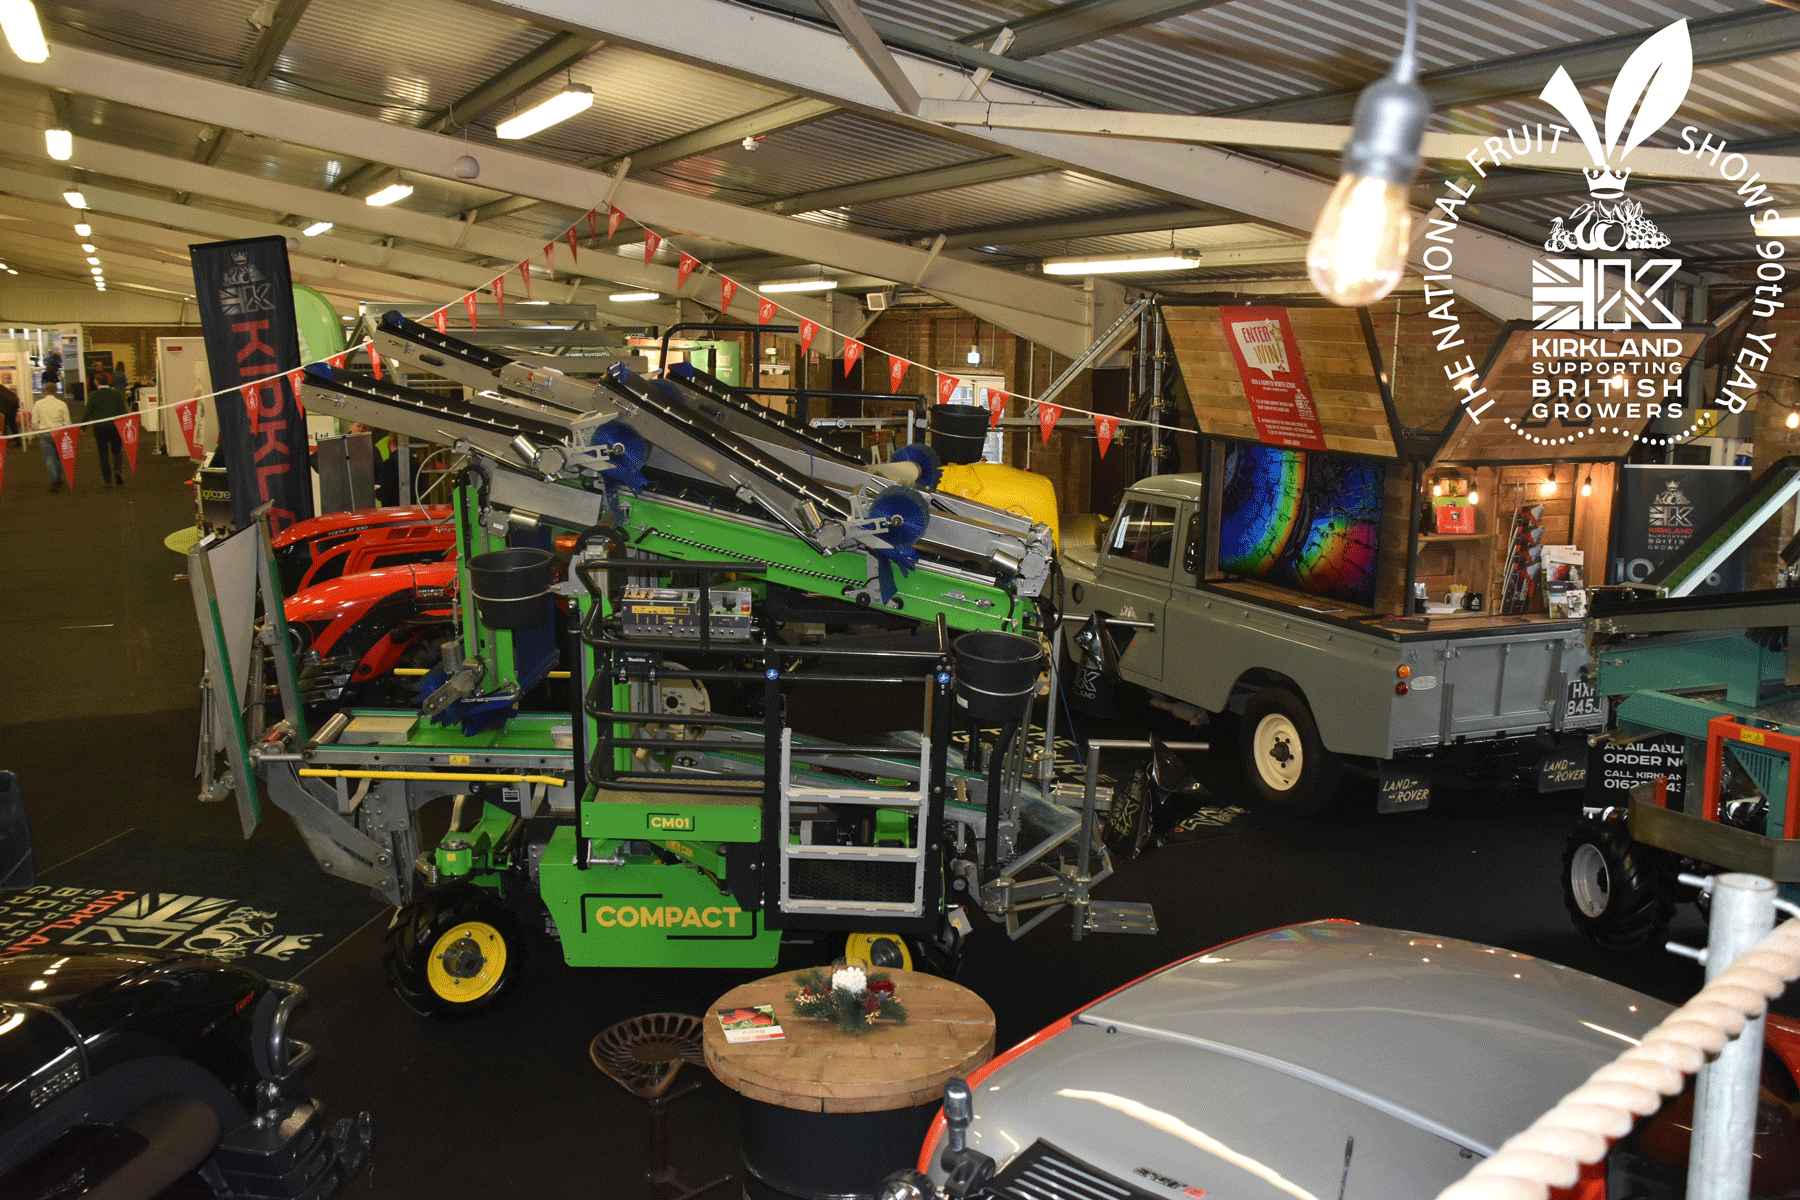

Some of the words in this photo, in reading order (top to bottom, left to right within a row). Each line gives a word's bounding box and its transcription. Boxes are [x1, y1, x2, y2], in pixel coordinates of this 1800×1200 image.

[1241, 325, 1272, 343] ENTER
[1253, 342, 1285, 365] WIN!
[231, 319, 298, 541] KIRKLA
[1649, 527, 1694, 535] KIRKLAND
[1567, 698, 1603, 716] 845J
[1603, 753, 1662, 766] ORDER
[1604, 769, 1634, 779] CALL
[651, 817, 690, 829] CM01
[0, 890, 137, 954] KIRKLAN
[595, 905, 742, 929] COMPACT
